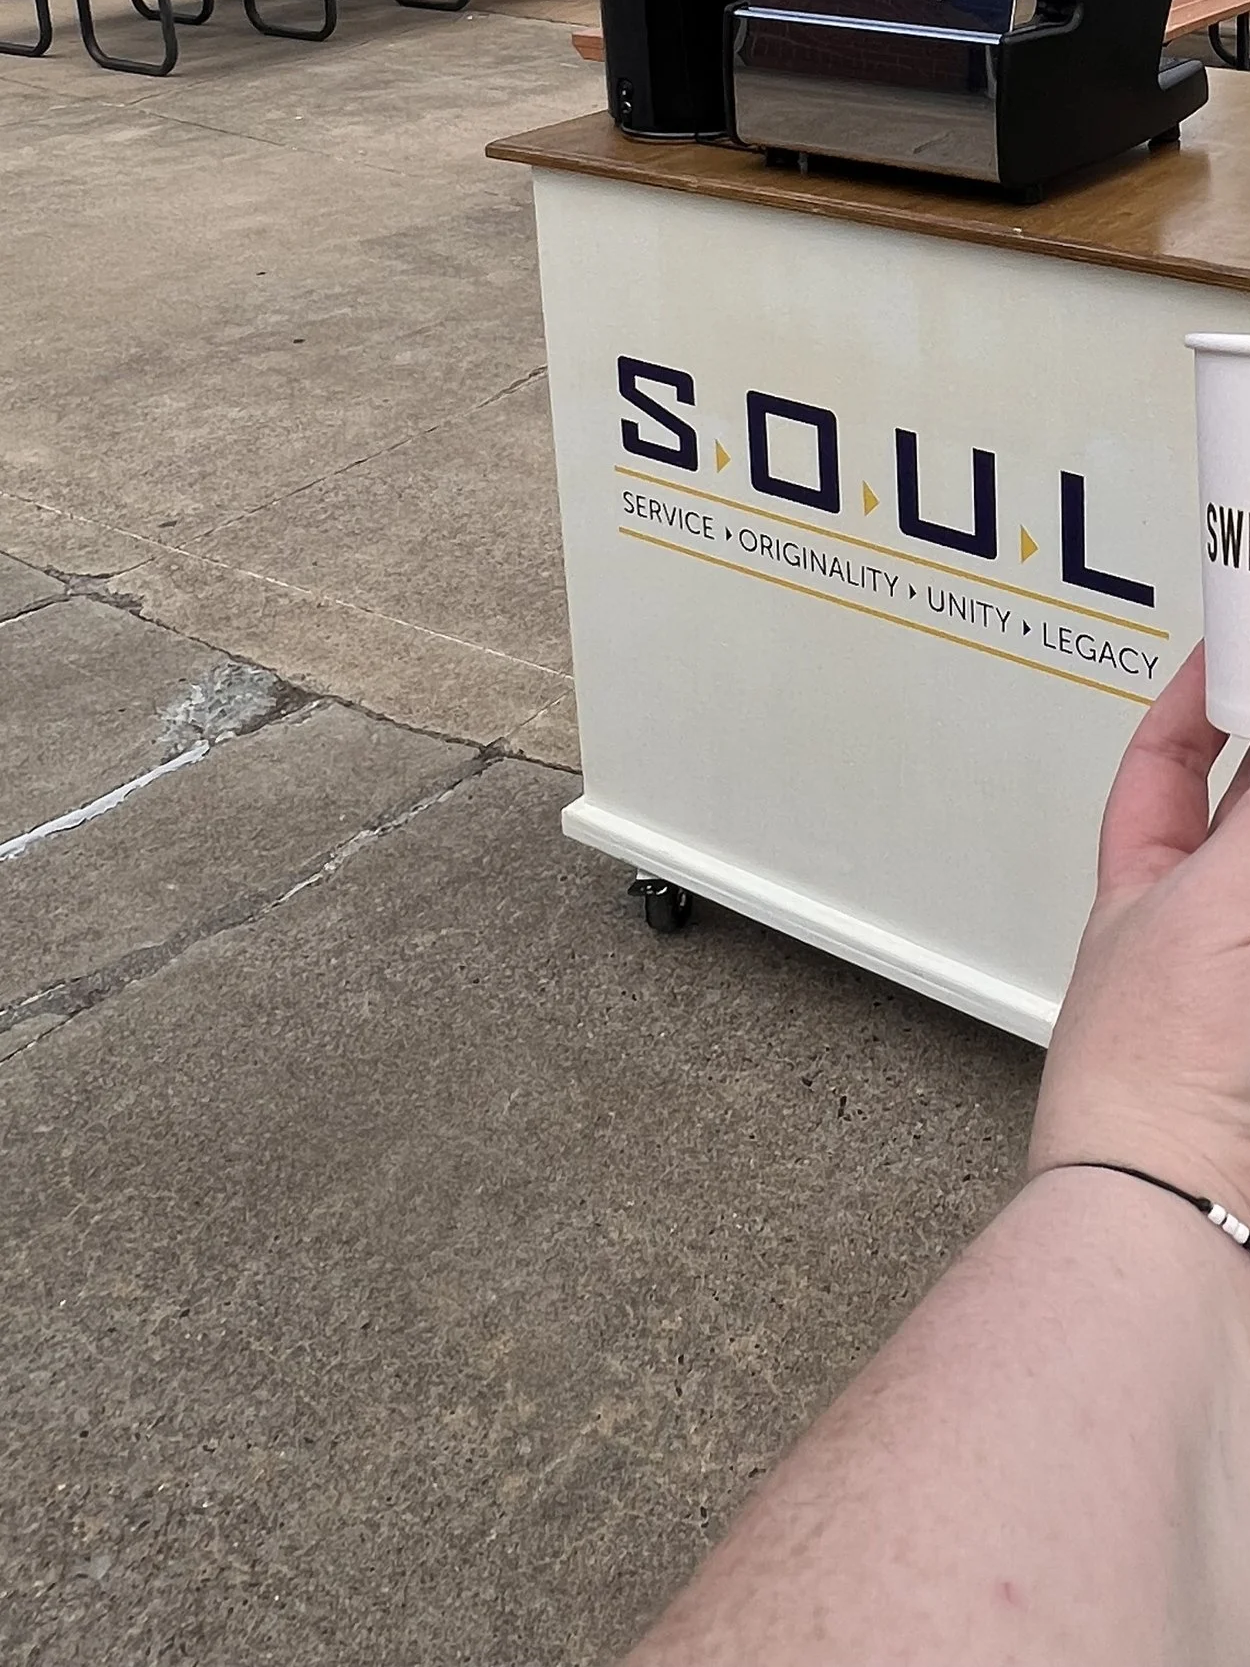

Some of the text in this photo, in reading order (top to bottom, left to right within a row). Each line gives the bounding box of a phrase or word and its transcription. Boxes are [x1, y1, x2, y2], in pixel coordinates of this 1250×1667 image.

[622, 490, 1159, 680] SERVICE ORIGINALITY UNITY LEGACY
